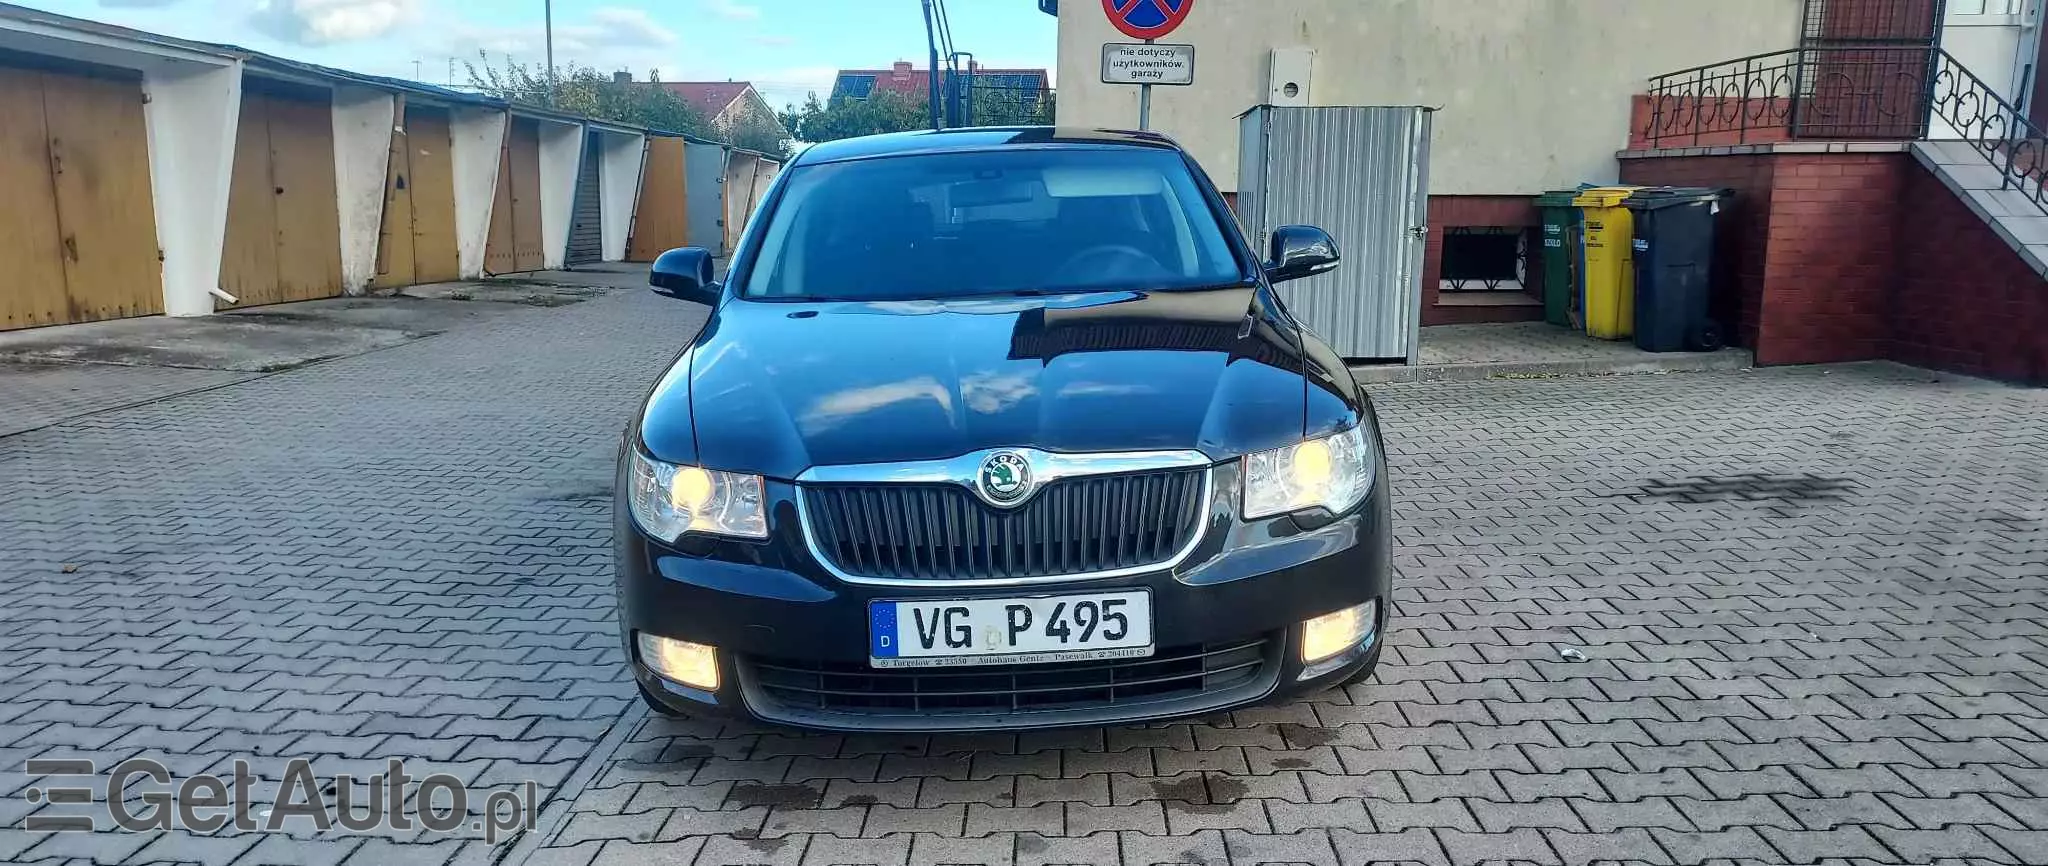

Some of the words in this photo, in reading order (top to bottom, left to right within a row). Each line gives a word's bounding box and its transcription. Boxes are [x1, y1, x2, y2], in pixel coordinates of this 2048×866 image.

[1120, 48, 1135, 56] nie
[1137, 48, 1176, 58] dotyczy
[913, 606, 972, 649] VG
[1005, 604, 1033, 646] P
[1045, 599, 1128, 643] 495
[880, 635, 890, 648] D
